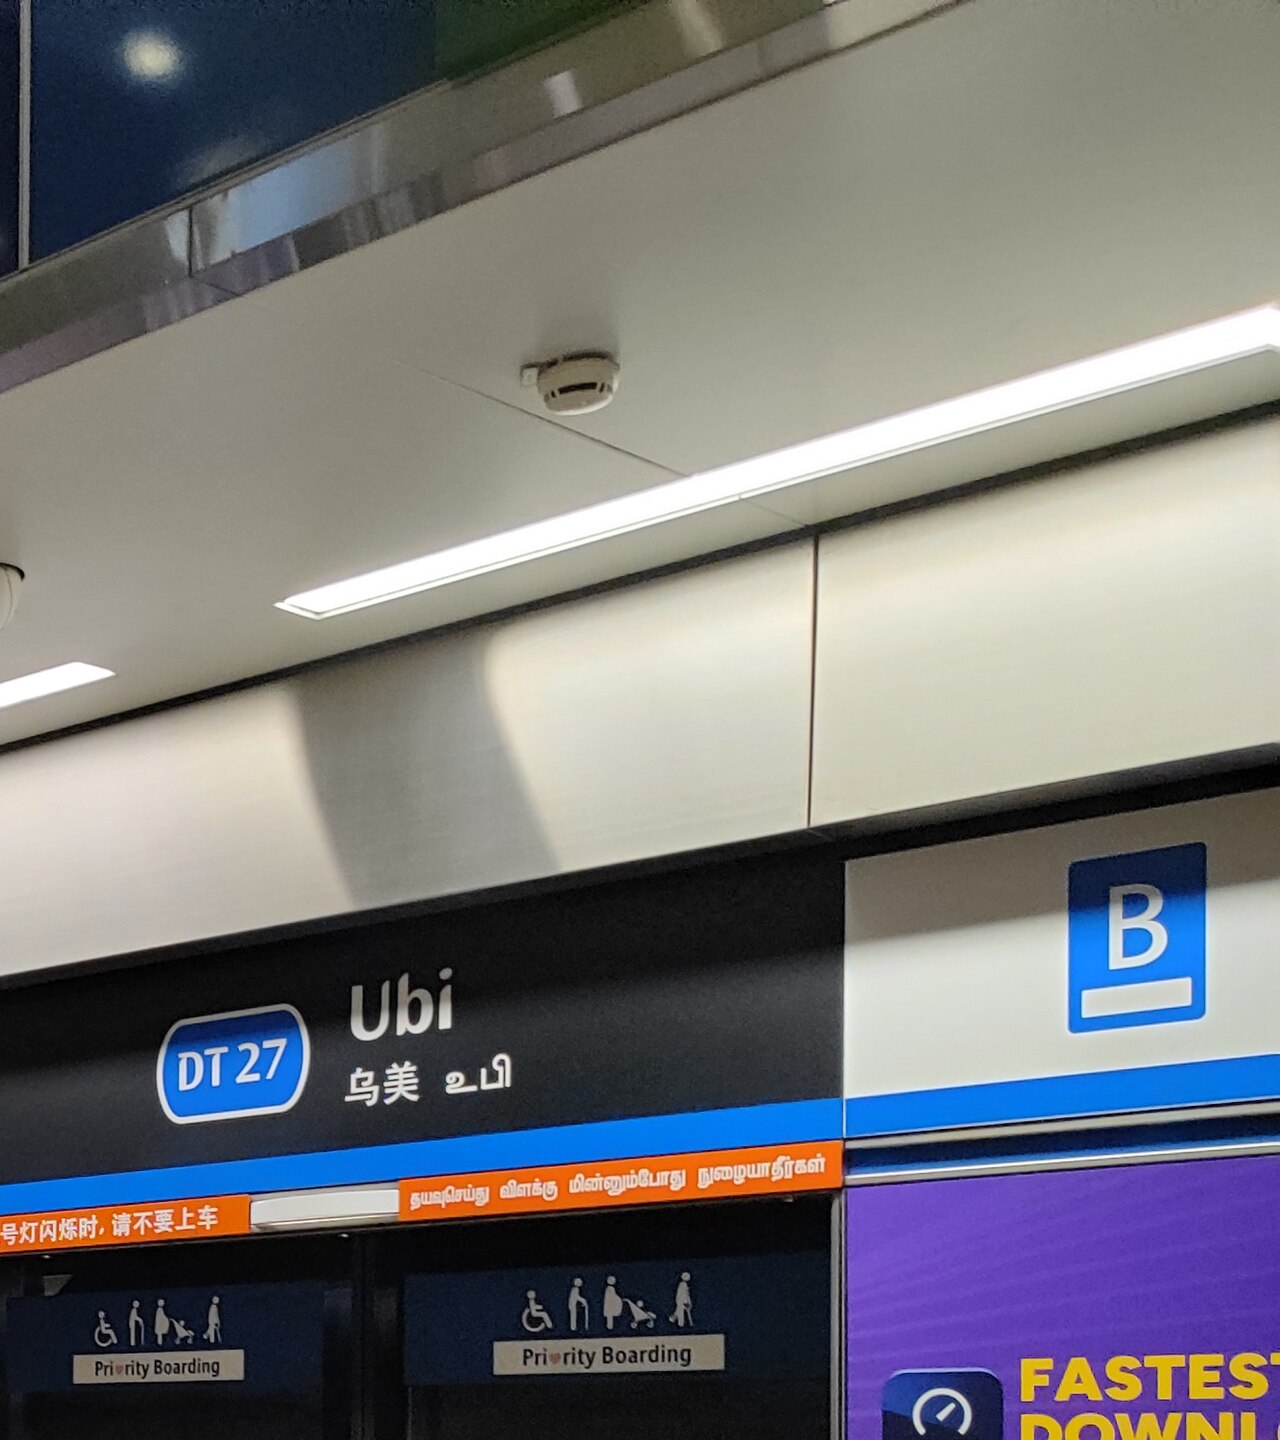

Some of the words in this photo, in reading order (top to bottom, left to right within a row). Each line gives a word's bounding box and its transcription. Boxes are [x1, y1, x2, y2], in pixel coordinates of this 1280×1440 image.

[1108, 883, 1169, 971] B
[350, 966, 453, 1042] Ubi
[177, 1046, 230, 1092] DT
[235, 1038, 288, 1085] 27
[344, 1060, 421, 1107] 乌美
[445, 1053, 513, 1094] உபி
[154, 1357, 221, 1378] Boarding
[602, 1344, 692, 1367] Boarding
[1019, 1352, 1280, 1402] FASTES
